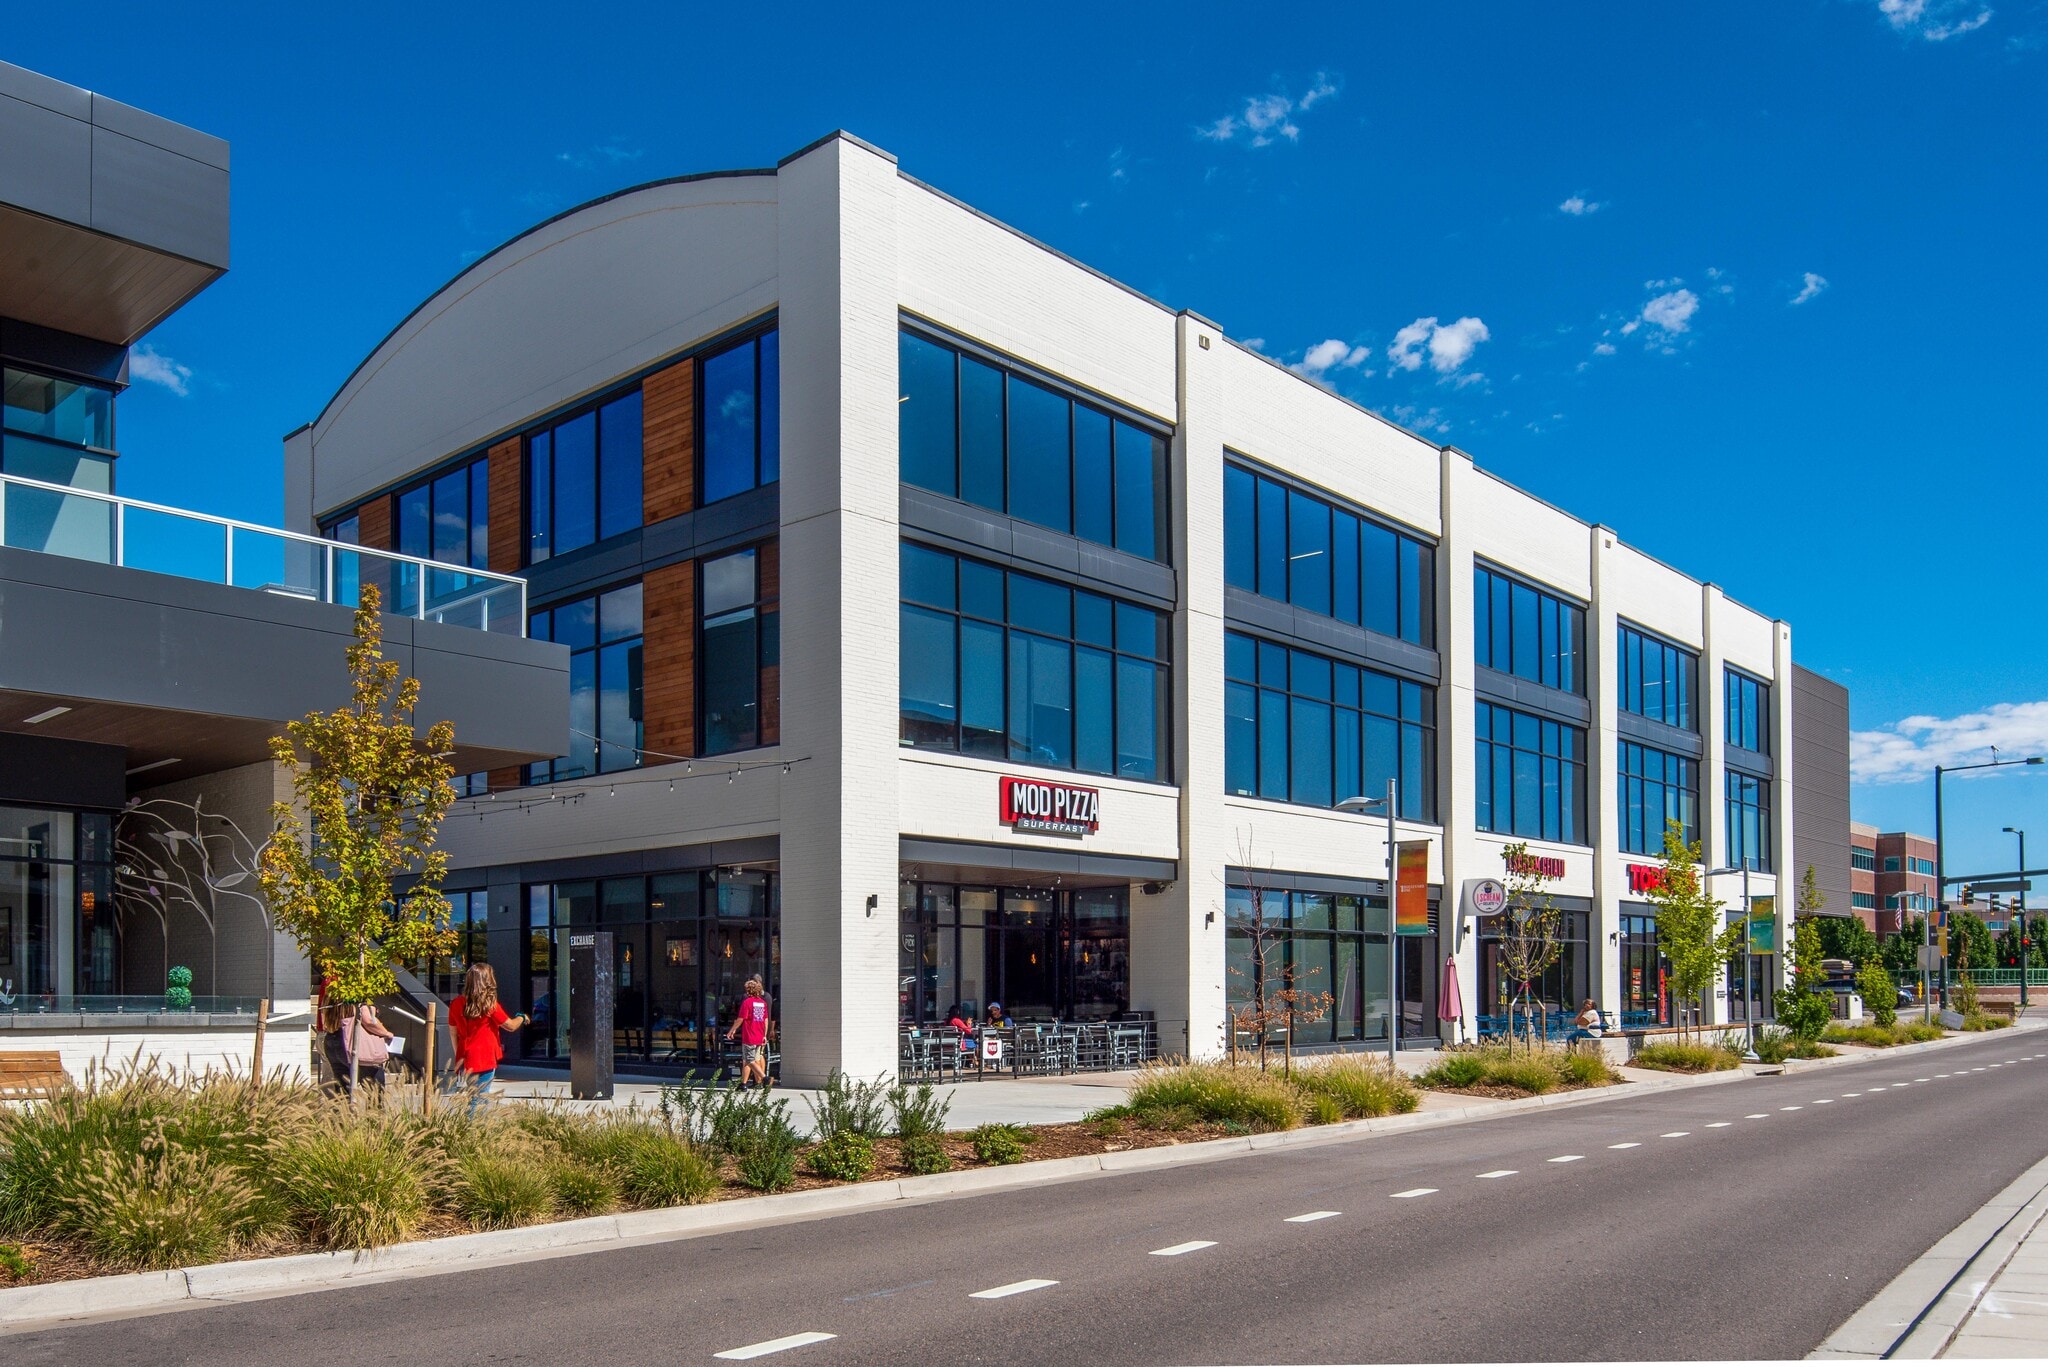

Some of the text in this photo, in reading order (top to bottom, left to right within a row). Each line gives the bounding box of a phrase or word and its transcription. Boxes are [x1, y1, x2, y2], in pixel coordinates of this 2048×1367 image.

[1013, 782, 1099, 822] MOD PIZZA
[1023, 820, 1085, 833] SUPERFAST
[1480, 893, 1501, 903] SCREAM
[570, 935, 595, 946] EXCHANGE
